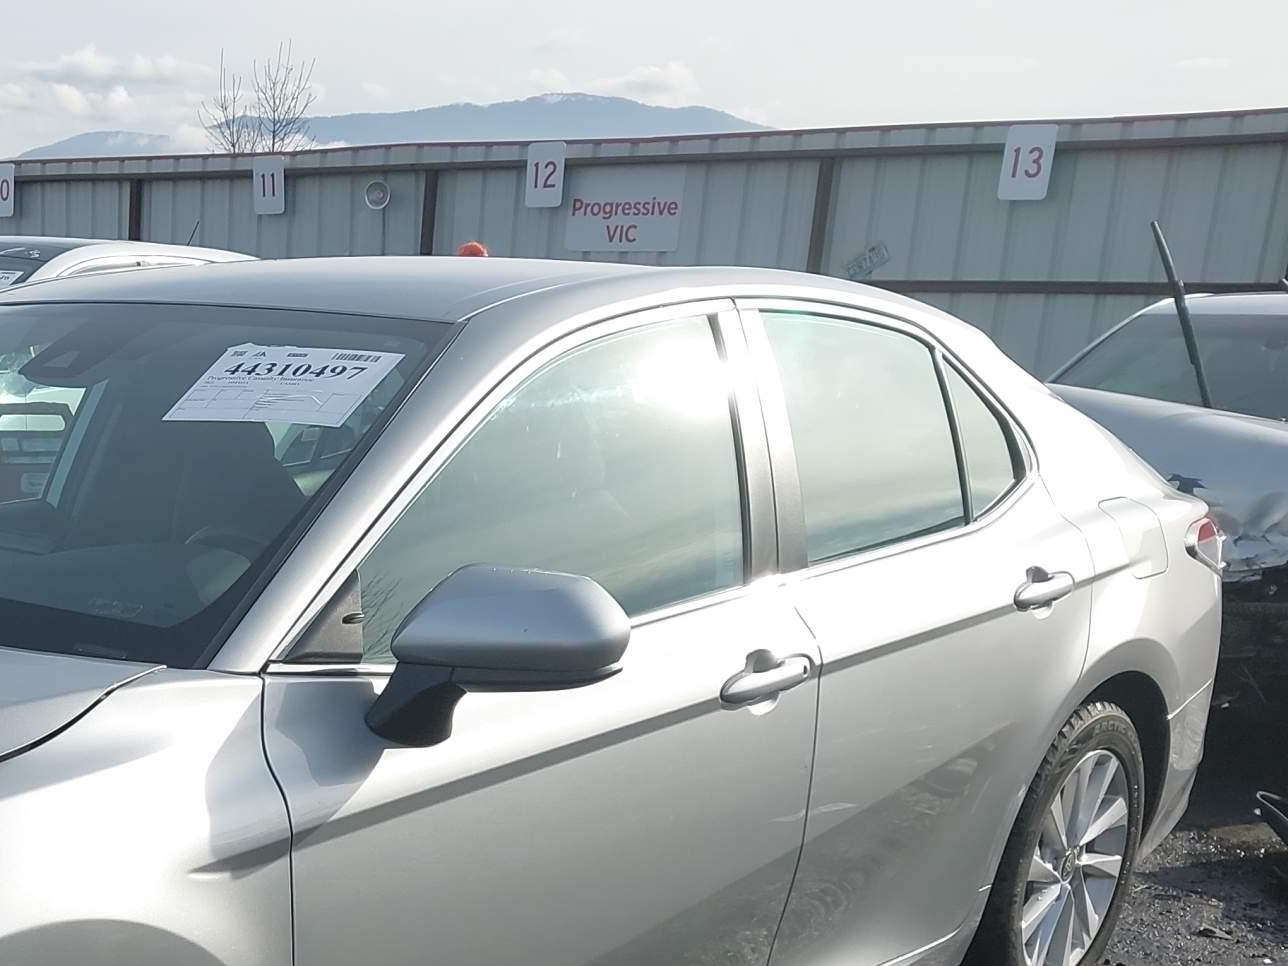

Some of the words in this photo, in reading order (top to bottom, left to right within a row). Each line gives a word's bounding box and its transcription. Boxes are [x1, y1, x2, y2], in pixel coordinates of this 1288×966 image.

[533, 160, 558, 189] 12
[1011, 146, 1044, 178] 13
[259, 172, 276, 198] 11
[571, 196, 679, 220] Progressive
[606, 224, 638, 243] VIC
[225, 362, 368, 380] 44310497
